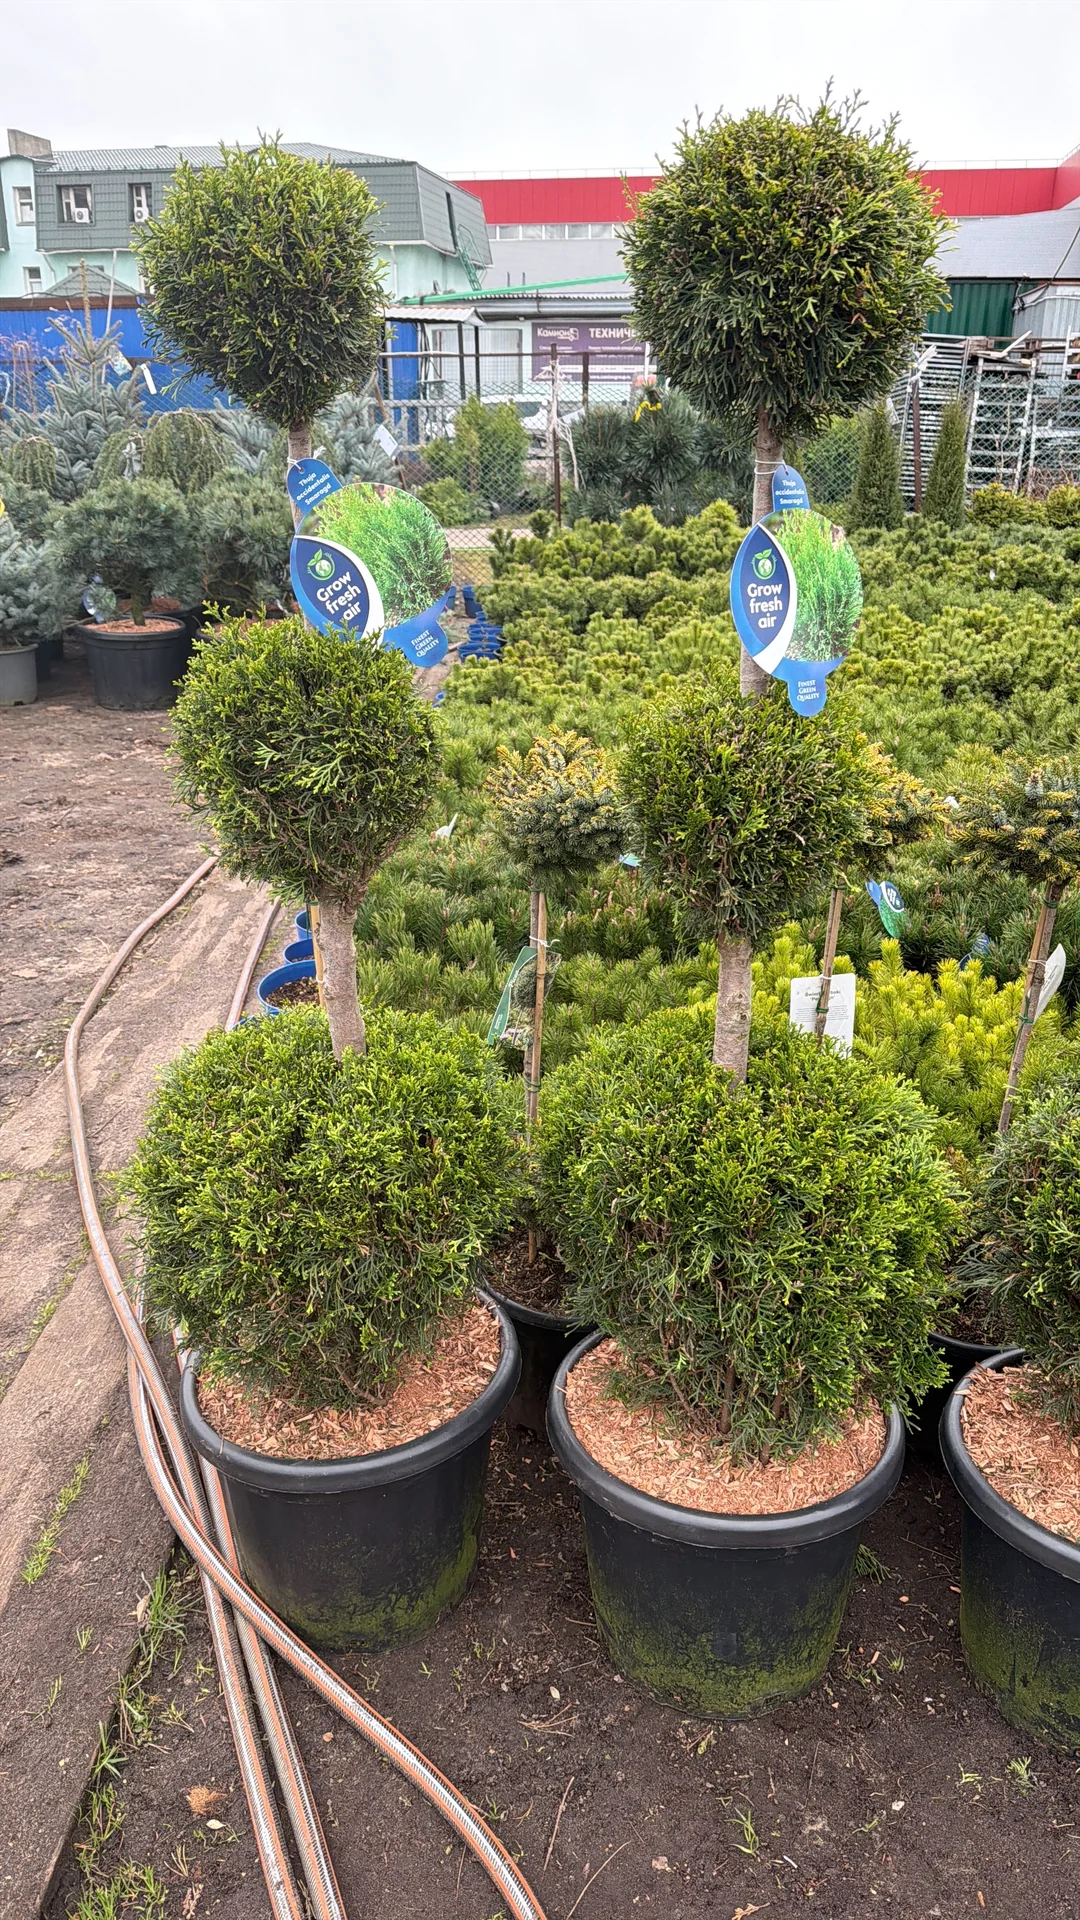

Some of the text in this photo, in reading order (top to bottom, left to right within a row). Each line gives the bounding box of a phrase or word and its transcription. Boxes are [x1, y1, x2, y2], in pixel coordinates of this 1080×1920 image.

[588, 327, 637, 339] ТЕХНИЧЕ
[296, 473, 331, 501] occidentalis
[298, 472, 316, 487] Thuja
[304, 482, 332, 506] Smaragd
[316, 571, 352, 602] Grow
[747, 583, 783, 598] Grow
[325, 584, 361, 615] fresh
[749, 595, 783, 614] fresh
[343, 601, 361, 621] air
[758, 612, 777, 629] air
[416, 638, 440, 658] QUALITY
[796, 692, 820, 702] QUALITY
